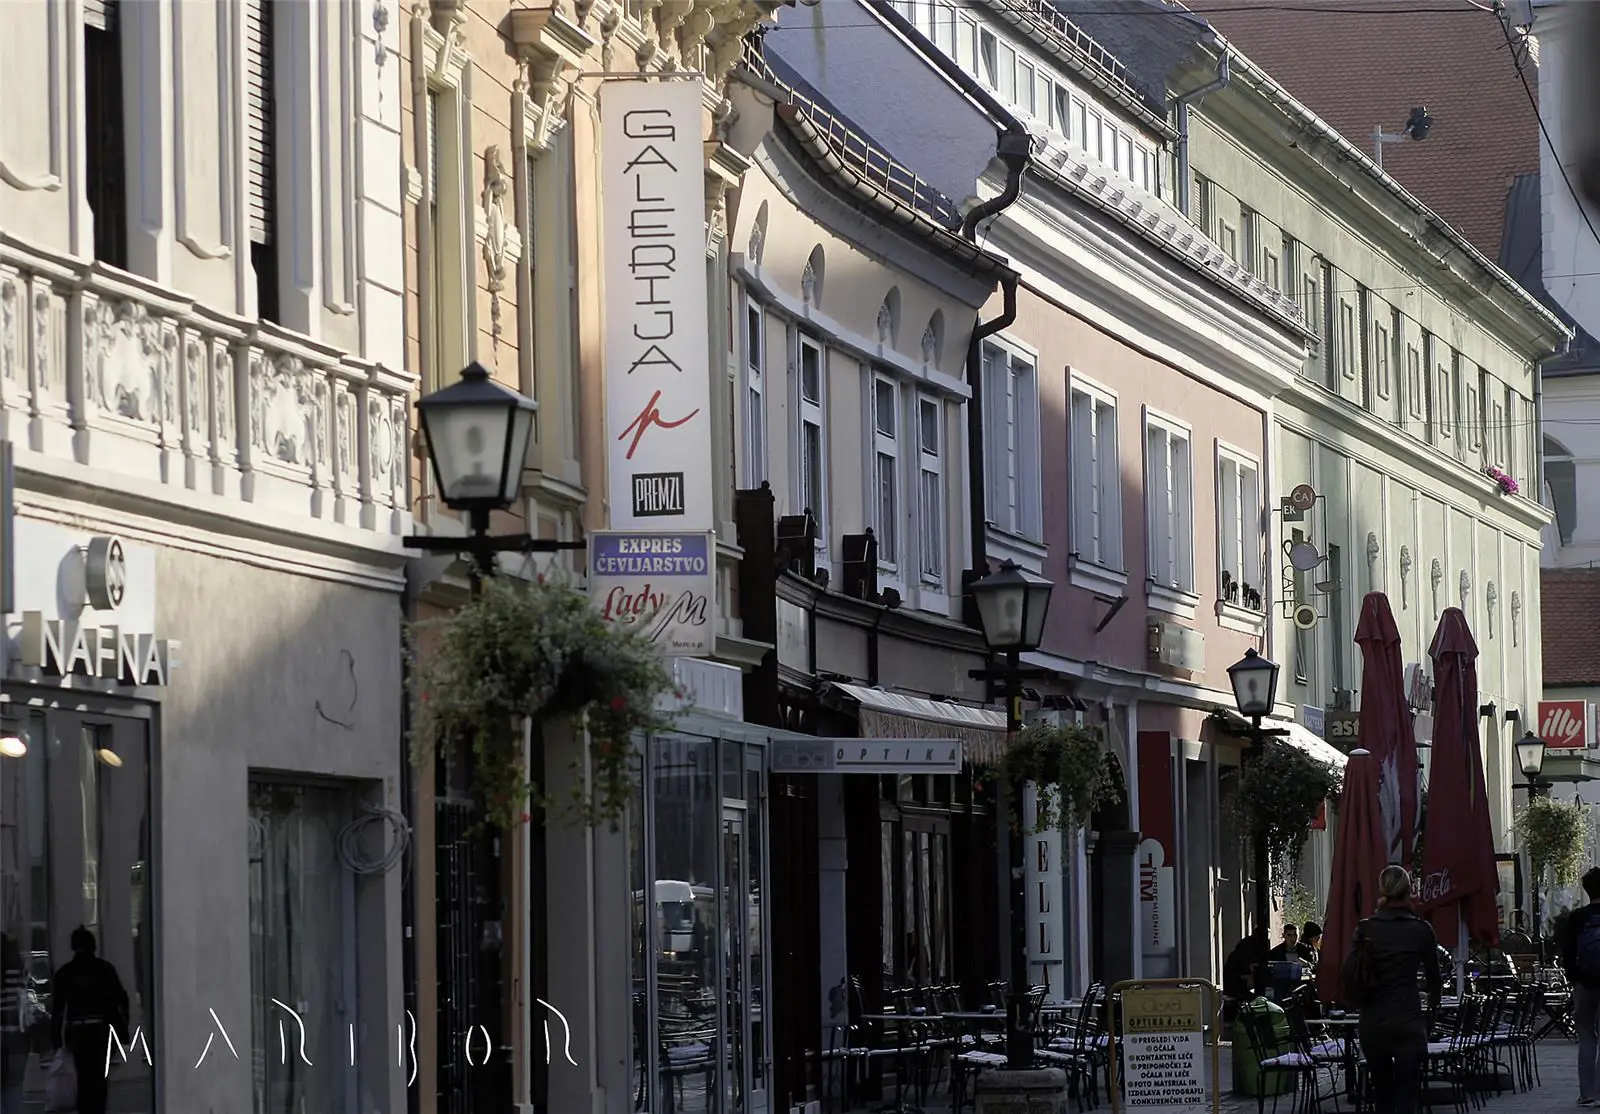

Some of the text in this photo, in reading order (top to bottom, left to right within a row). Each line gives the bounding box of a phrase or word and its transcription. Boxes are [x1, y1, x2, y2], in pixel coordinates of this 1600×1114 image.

[623, 109, 682, 375] GALERIJA
[635, 476, 683, 513] PREMZL
[618, 538, 682, 554] EXPRES
[596, 552, 705, 573] ČEVLJARSTVO
[39, 618, 183, 686] NAFNAF
[1541, 708, 1582, 743] illy
[837, 748, 956, 761] OPTIKA
[1129, 1018, 1164, 1027] OPTIKA
